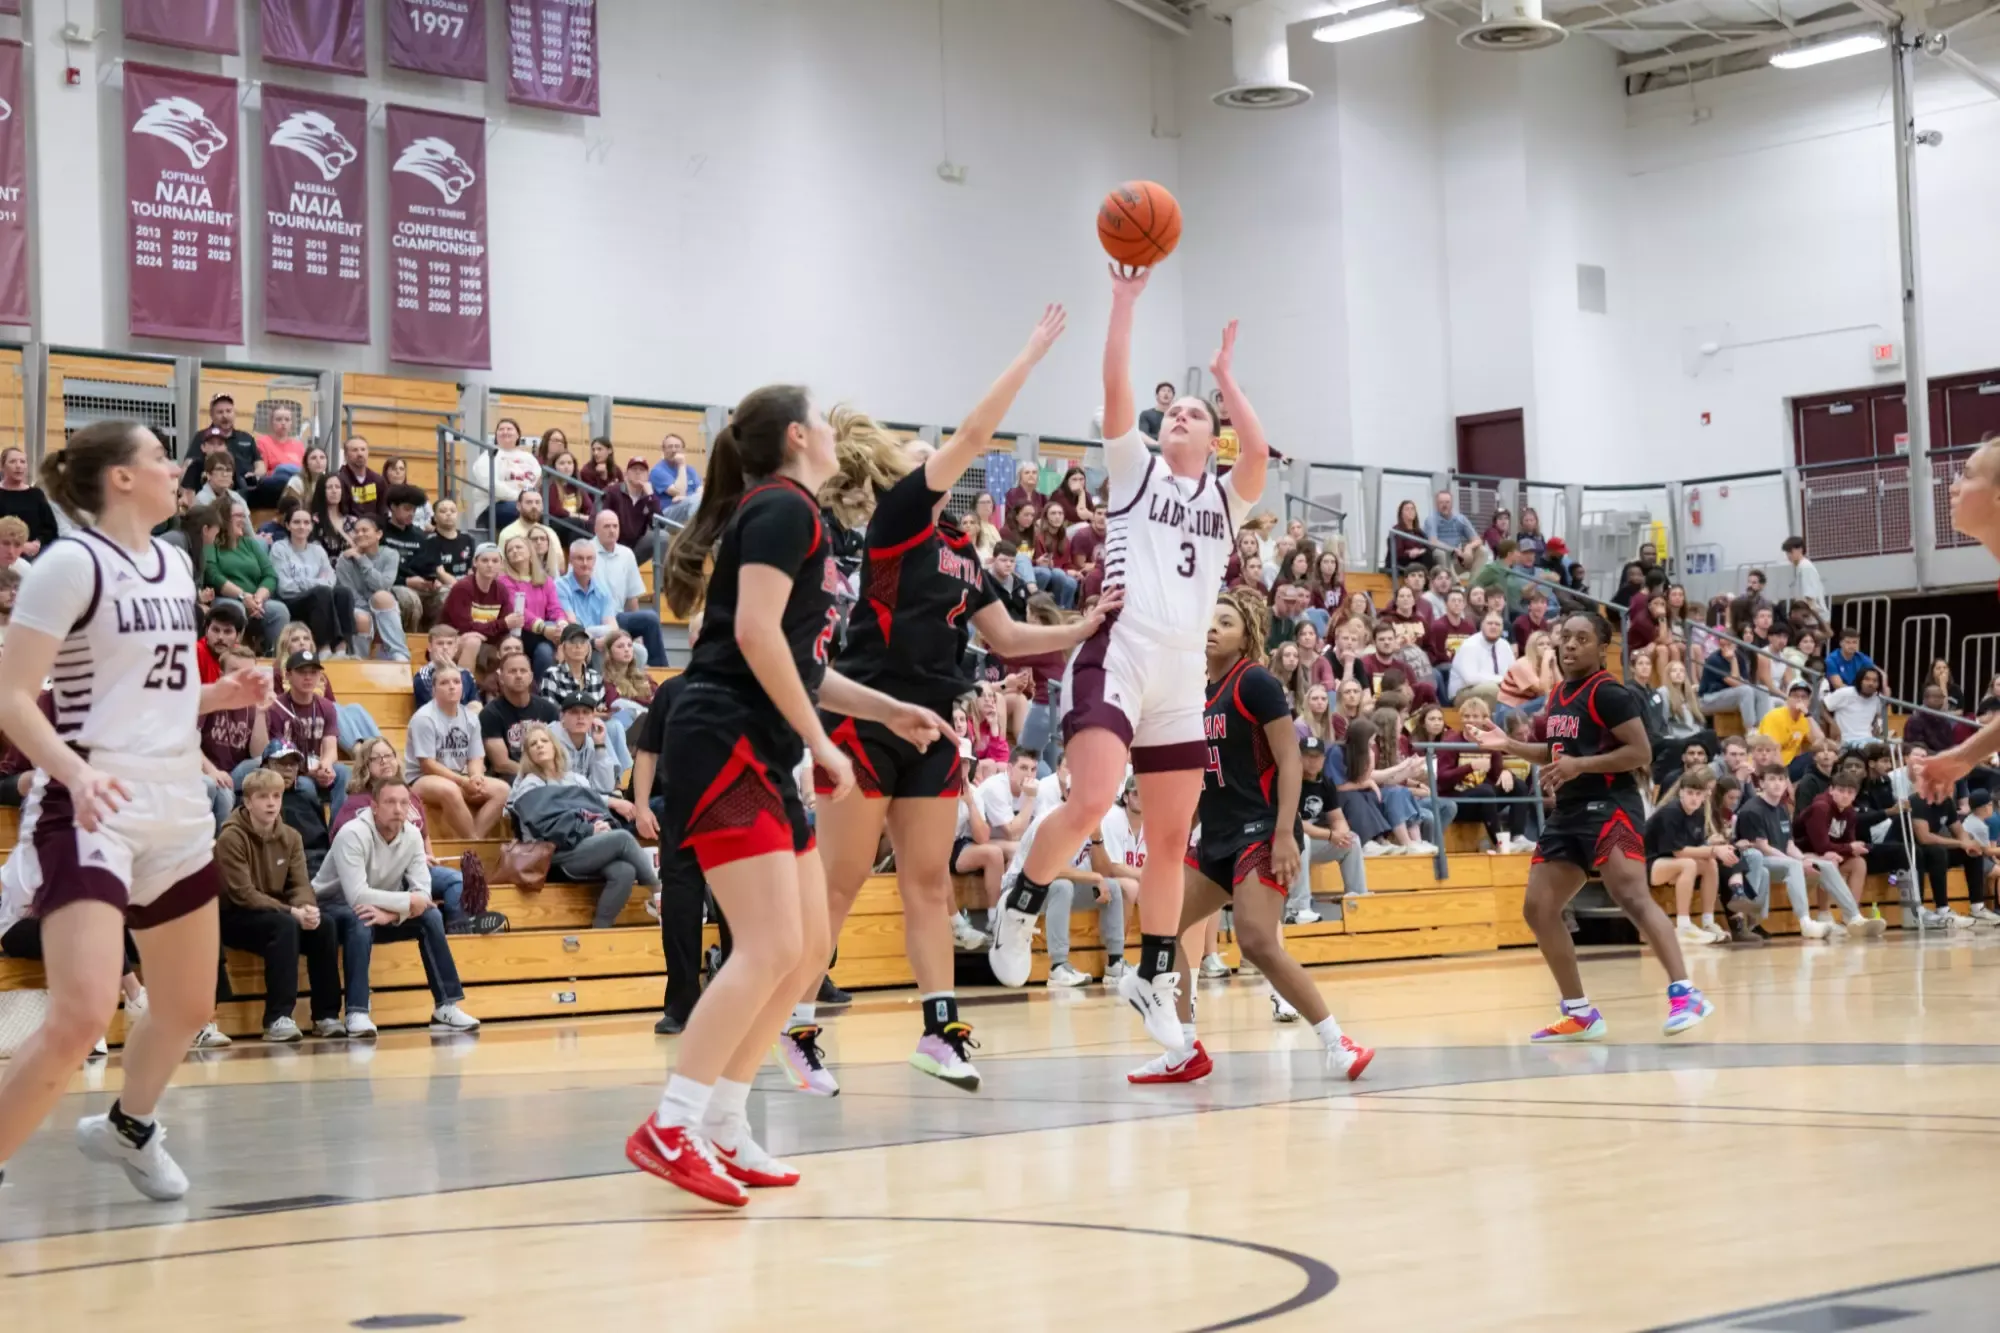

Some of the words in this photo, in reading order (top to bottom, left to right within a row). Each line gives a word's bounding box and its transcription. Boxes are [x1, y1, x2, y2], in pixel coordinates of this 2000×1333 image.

[409, 9, 465, 38] 1997
[542, 74, 563, 86] 2007
[161, 169, 206, 184] SOFTBALL
[156, 181, 213, 208] NAIA
[294, 181, 337, 196] BASEBALL
[131, 200, 233, 227] TOURNAMENT
[290, 192, 343, 219] NAIA
[408, 204, 435, 217] MEN'S
[437, 208, 466, 220] TENNIS
[268, 211, 363, 237] TOURNAMENT
[398, 221, 477, 243] CONFERENCE
[136, 224, 161, 239] 2013
[173, 229, 198, 242] 2017
[208, 234, 231, 247] 2018
[272, 234, 293, 246] 2012
[392, 234, 484, 257] CHAMPIONSHIP
[136, 240, 161, 253] 2021
[172, 244, 197, 257] 2022
[208, 249, 231, 262] 2023
[306, 251, 327, 263] 2019
[340, 256, 359, 267] 2021
[136, 254, 162, 267] 2024
[172, 259, 197, 271] 2025
[428, 261, 450, 274] 1993
[428, 275, 451, 286] 1997
[459, 305, 483, 316] 2007
[1148, 493, 1185, 530] LADY
[1188, 507, 1224, 540] LIONS
[1177, 541, 1196, 578] 3
[114, 597, 166, 634] LADY
[163, 597, 197, 631] LIO
[143, 643, 189, 691] 25
[1201, 745, 1226, 790] 4
